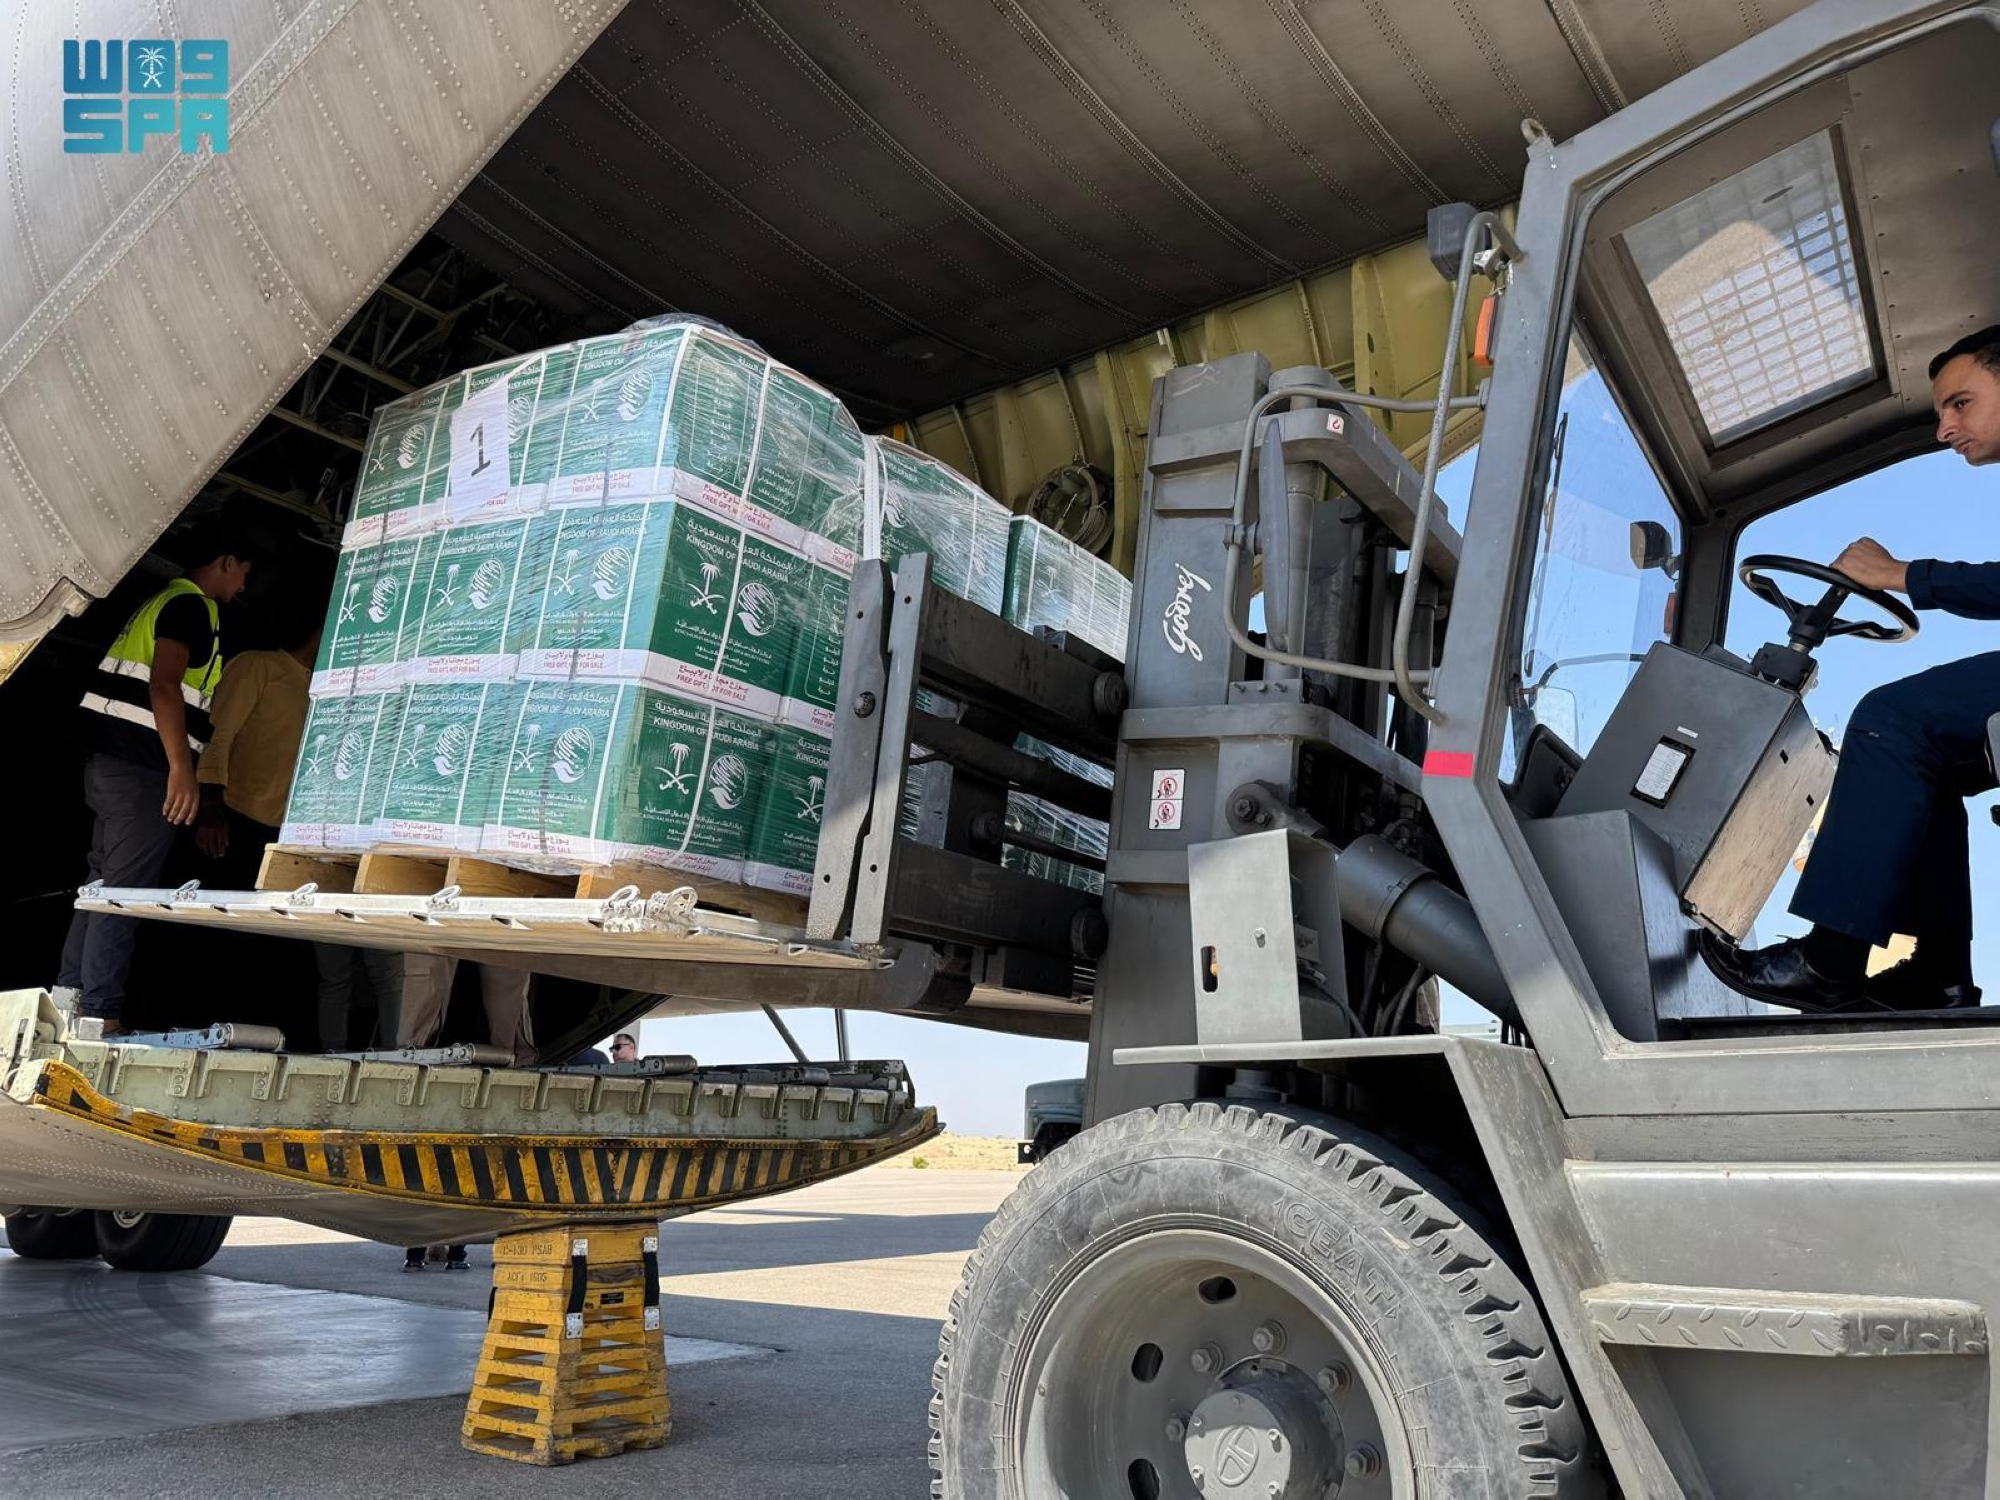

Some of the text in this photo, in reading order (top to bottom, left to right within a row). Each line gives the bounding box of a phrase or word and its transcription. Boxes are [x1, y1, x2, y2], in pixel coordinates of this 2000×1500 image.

[469, 421, 491, 477] 1
[688, 517, 729, 544] السعودية
[686, 533, 790, 584] KINGDOM OF AUDI ARABIA
[1163, 563, 1212, 662] Godrej
[676, 674, 691, 685] FREE
[655, 700, 700, 720] السعودية
[653, 716, 760, 750] KINGDOM OF AUDI ARABIA
[798, 738, 830, 755] سعودية
[1278, 1202, 1396, 1306] CEAT
